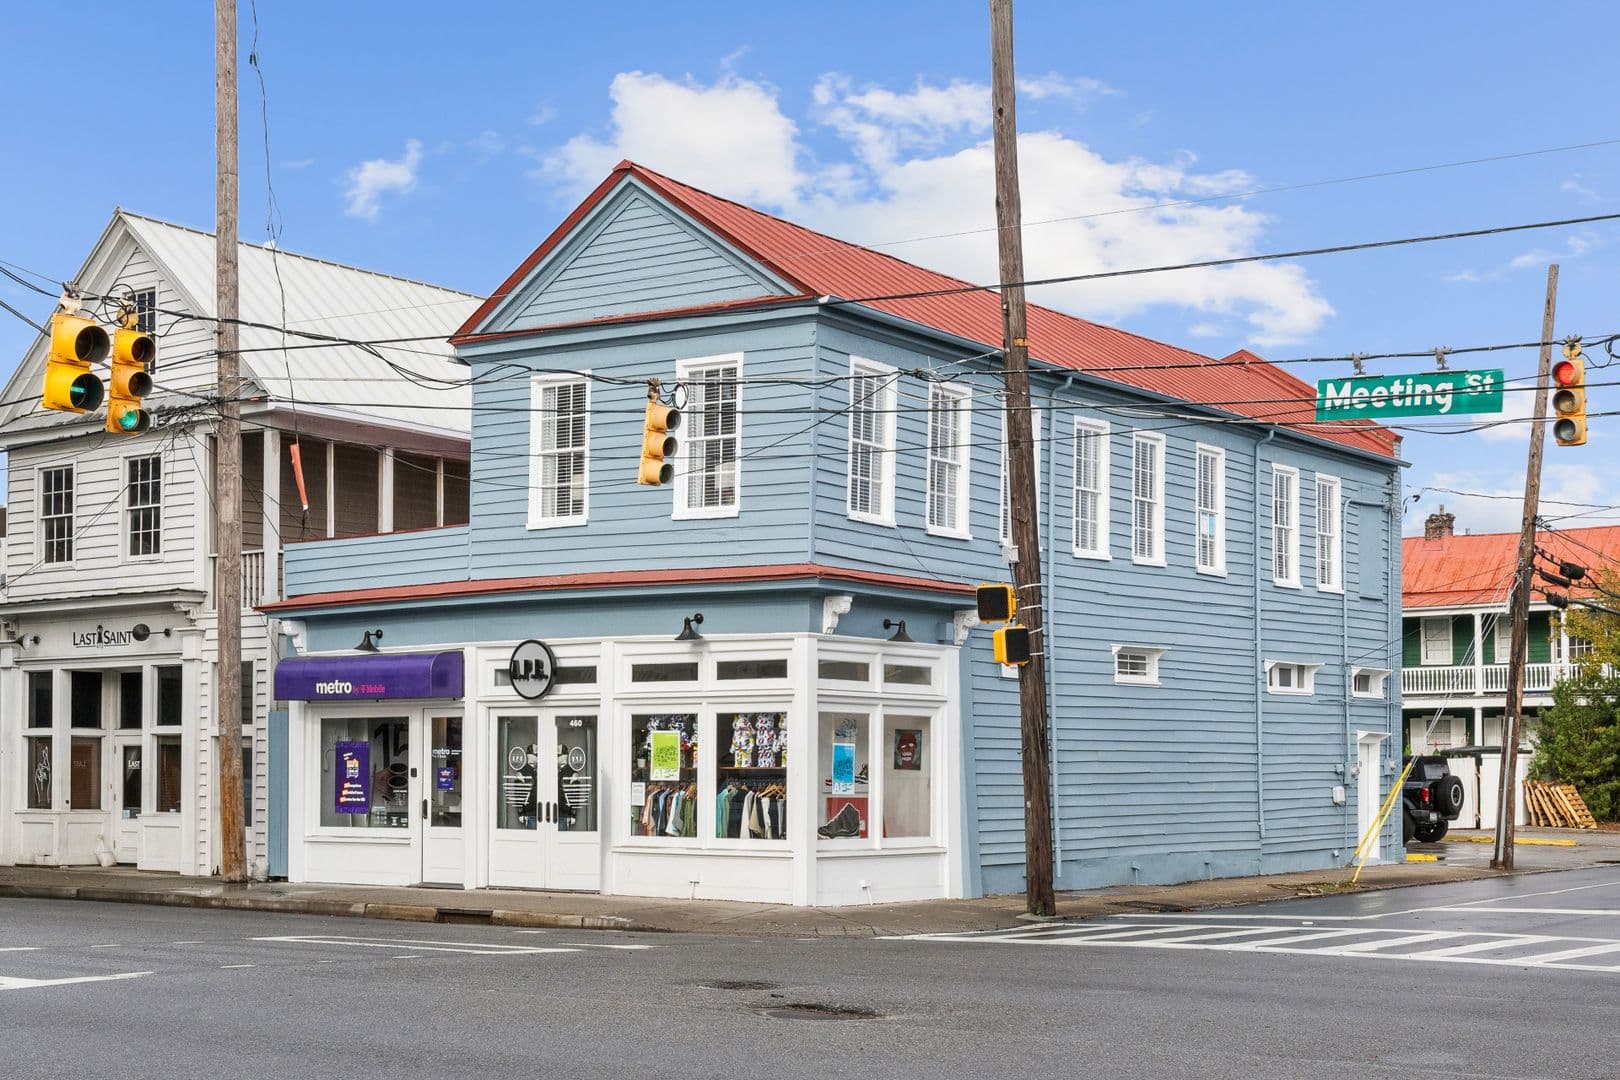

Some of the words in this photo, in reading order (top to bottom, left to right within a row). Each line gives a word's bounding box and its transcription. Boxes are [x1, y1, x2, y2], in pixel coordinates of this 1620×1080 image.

[1325, 378, 1453, 413] Meeting
[1466, 374, 1494, 396] St
[73, 631, 97, 646] LAST
[103, 630, 133, 645] SAINT
[316, 680, 352, 694] metro
[569, 720, 583, 728] 460
